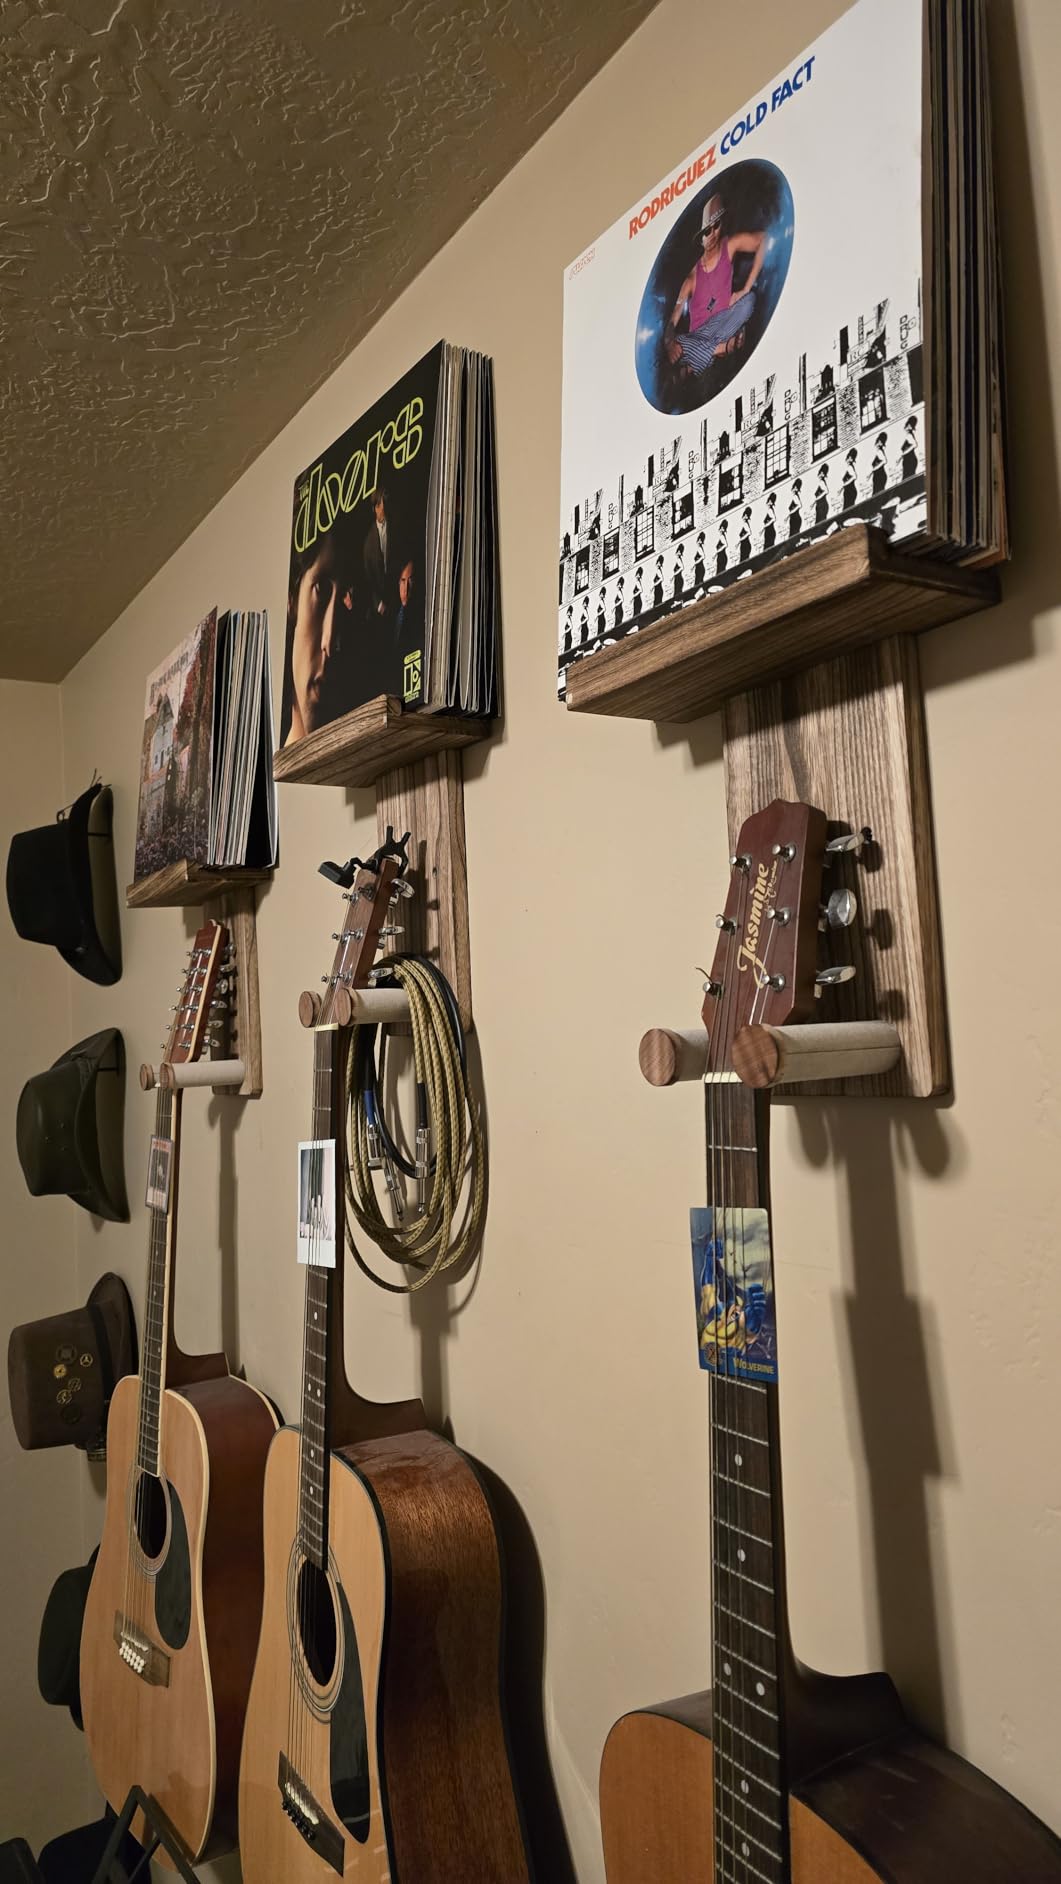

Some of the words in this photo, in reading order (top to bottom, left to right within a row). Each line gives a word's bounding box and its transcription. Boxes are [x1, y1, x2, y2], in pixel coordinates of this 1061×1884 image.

[628, 143, 717, 240] RODRIGUEZ
[720, 102, 767, 155] COLD
[771, 56, 816, 113] FACT
[900, 314, 908, 350] DRUG
[737, 863, 770, 989] Jasmine
[733, 1357, 775, 1375] WOLVERINE
